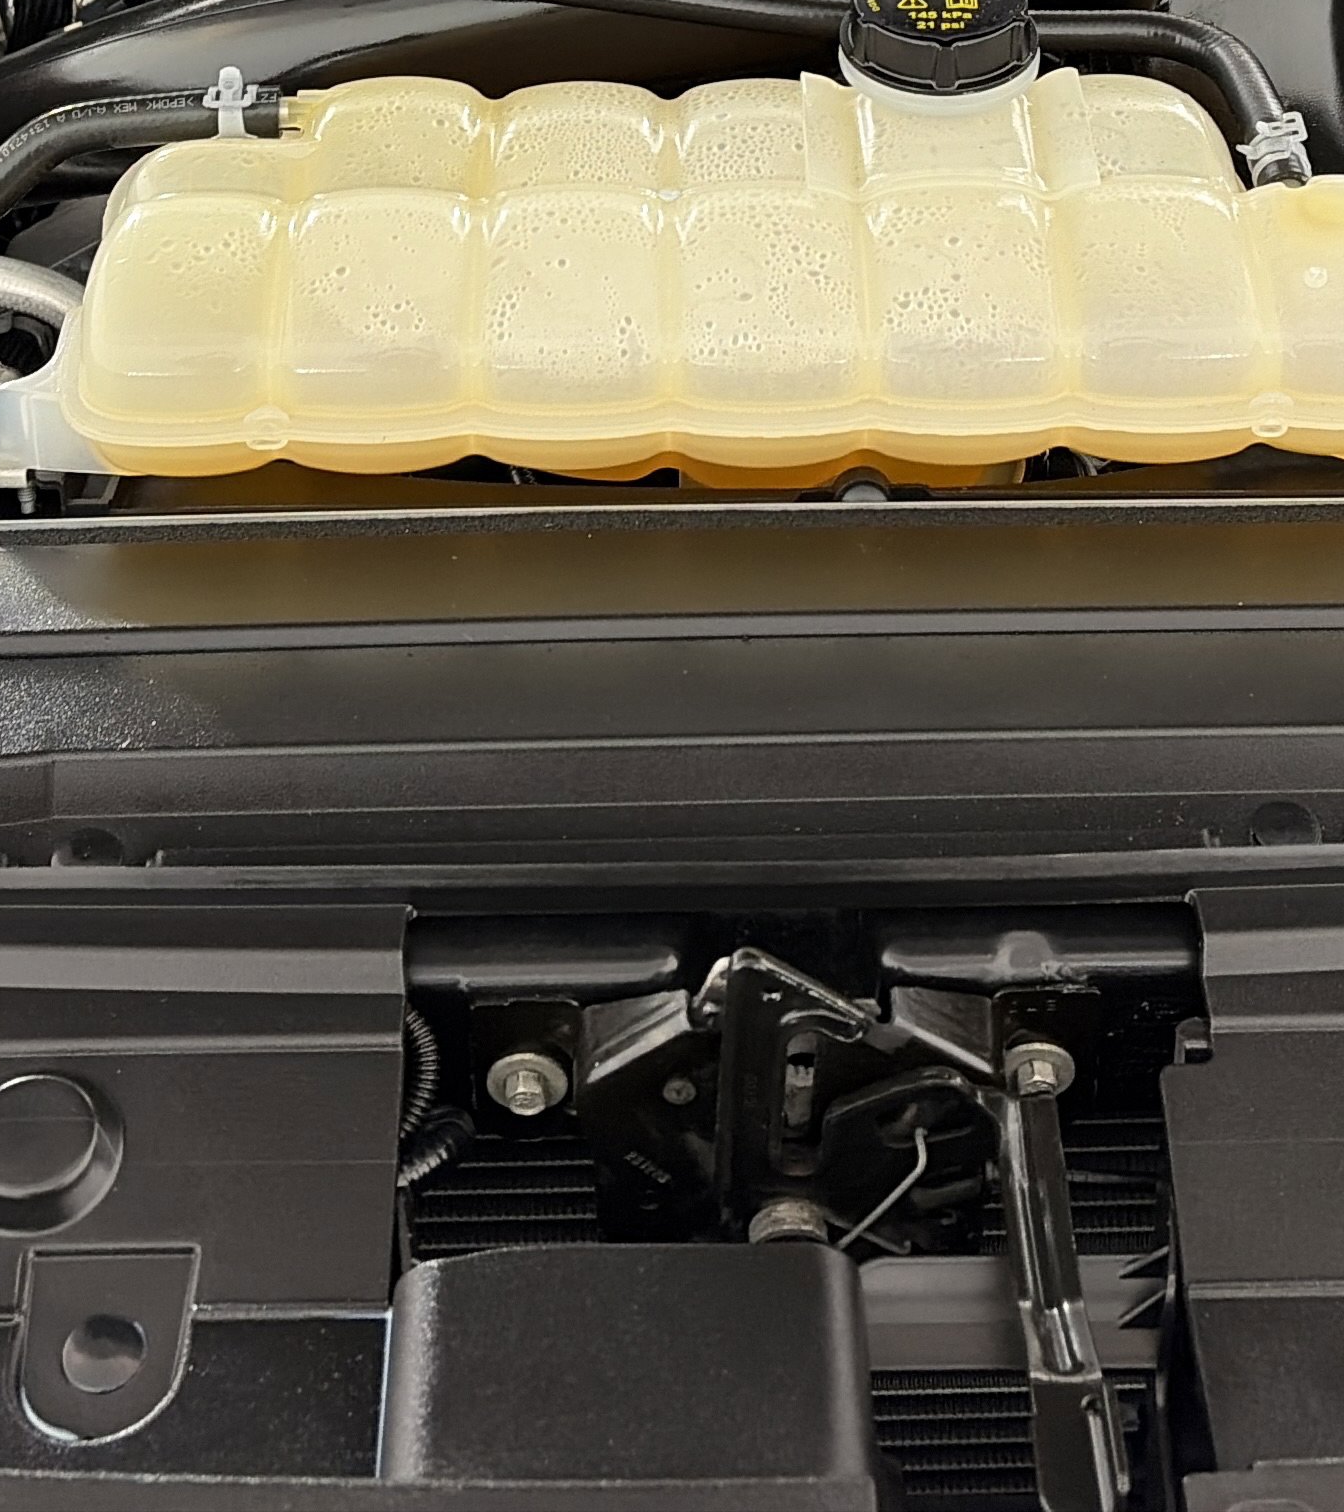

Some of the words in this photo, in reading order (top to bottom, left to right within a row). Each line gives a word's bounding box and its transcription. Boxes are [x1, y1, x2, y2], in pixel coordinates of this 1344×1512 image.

[907, 11, 938, 19] 145
[941, 11, 973, 19] kPa
[916, 21, 931, 29] 21
[941, 21, 965, 30] psi
[113, 101, 138, 113] MEX
[145, 95, 194, 110] >EPDM<
